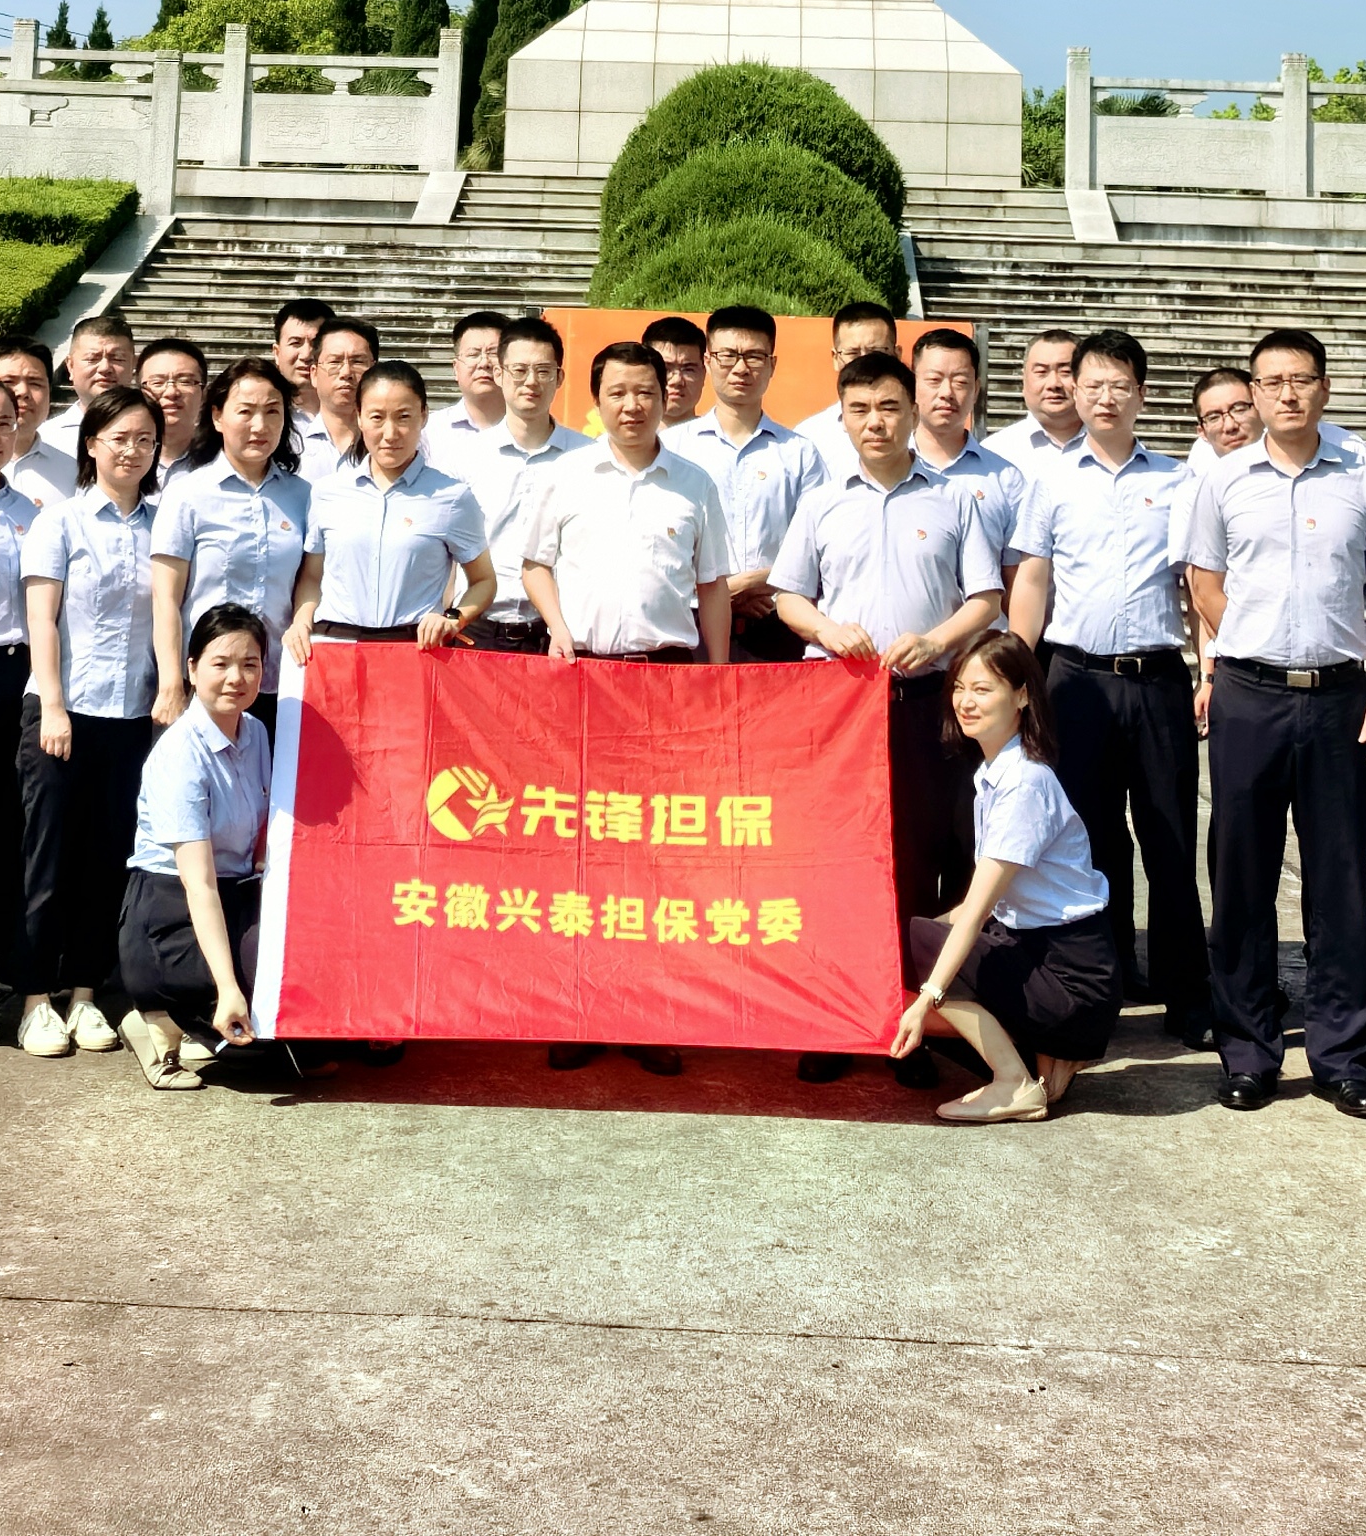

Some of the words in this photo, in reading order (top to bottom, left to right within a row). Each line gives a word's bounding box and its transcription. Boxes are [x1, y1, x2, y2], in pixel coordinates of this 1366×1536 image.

[520, 784, 774, 848] 先锋担保
[391, 876, 804, 946] 安徽兴泰担保党委
